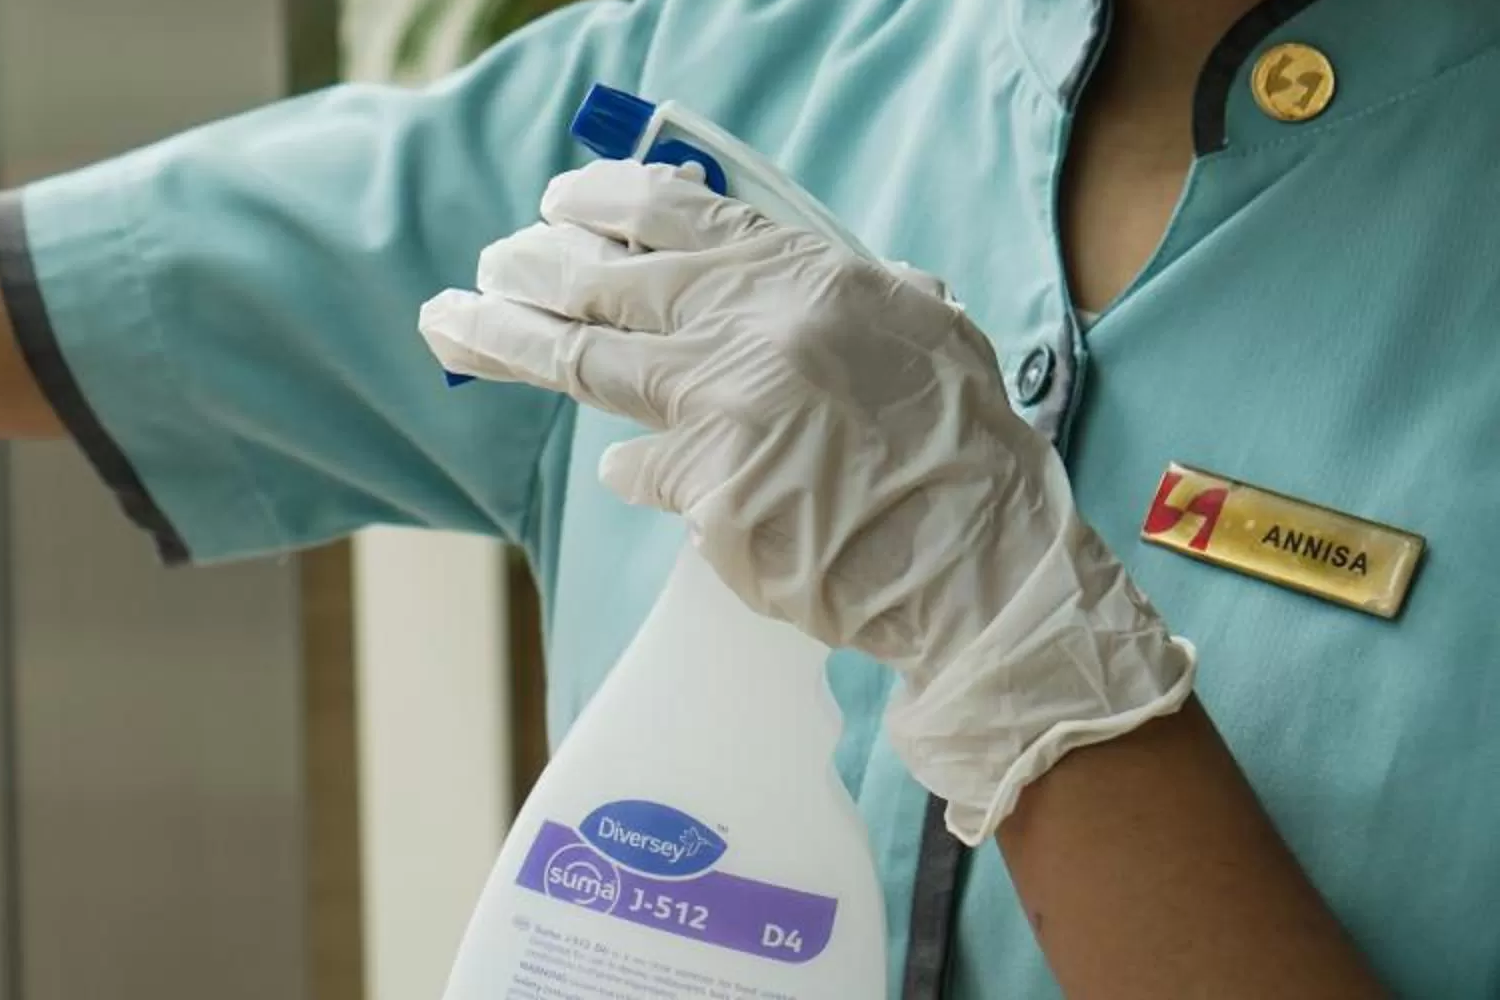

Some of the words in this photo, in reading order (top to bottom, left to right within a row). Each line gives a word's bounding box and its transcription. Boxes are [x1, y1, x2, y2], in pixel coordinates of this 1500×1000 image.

[1262, 526, 1367, 576] ANNISA
[598, 816, 684, 864] Diversey
[550, 865, 615, 900] suma
[628, 888, 709, 930] J-512
[761, 923, 803, 953] D4
